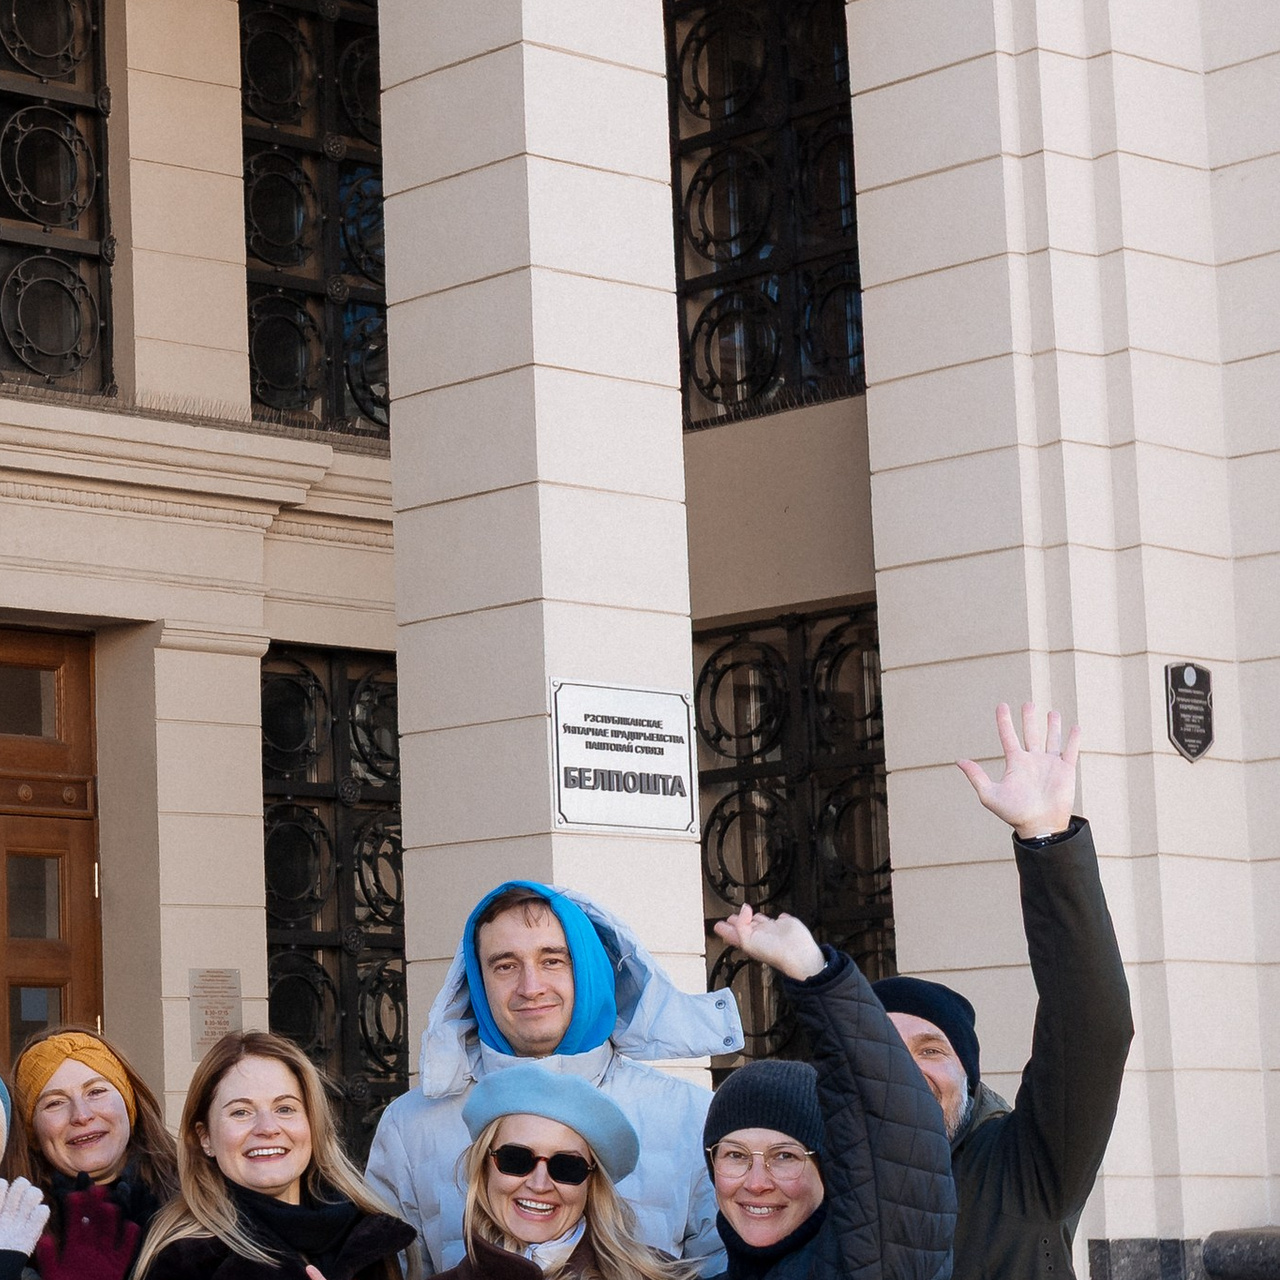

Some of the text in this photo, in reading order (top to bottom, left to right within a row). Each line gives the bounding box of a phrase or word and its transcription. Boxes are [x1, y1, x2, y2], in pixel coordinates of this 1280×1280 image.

[583, 713, 663, 729] РЭСПУБЛІКАНСКАЕ
[562, 723, 685, 744] ЎНІТАРНАЕ ПРАДПРЫЕМСТВА
[585, 741, 664, 756] ПАШТОВАЙ СУВЯЗІ
[563, 766, 687, 797] БЕЛПОШТА
